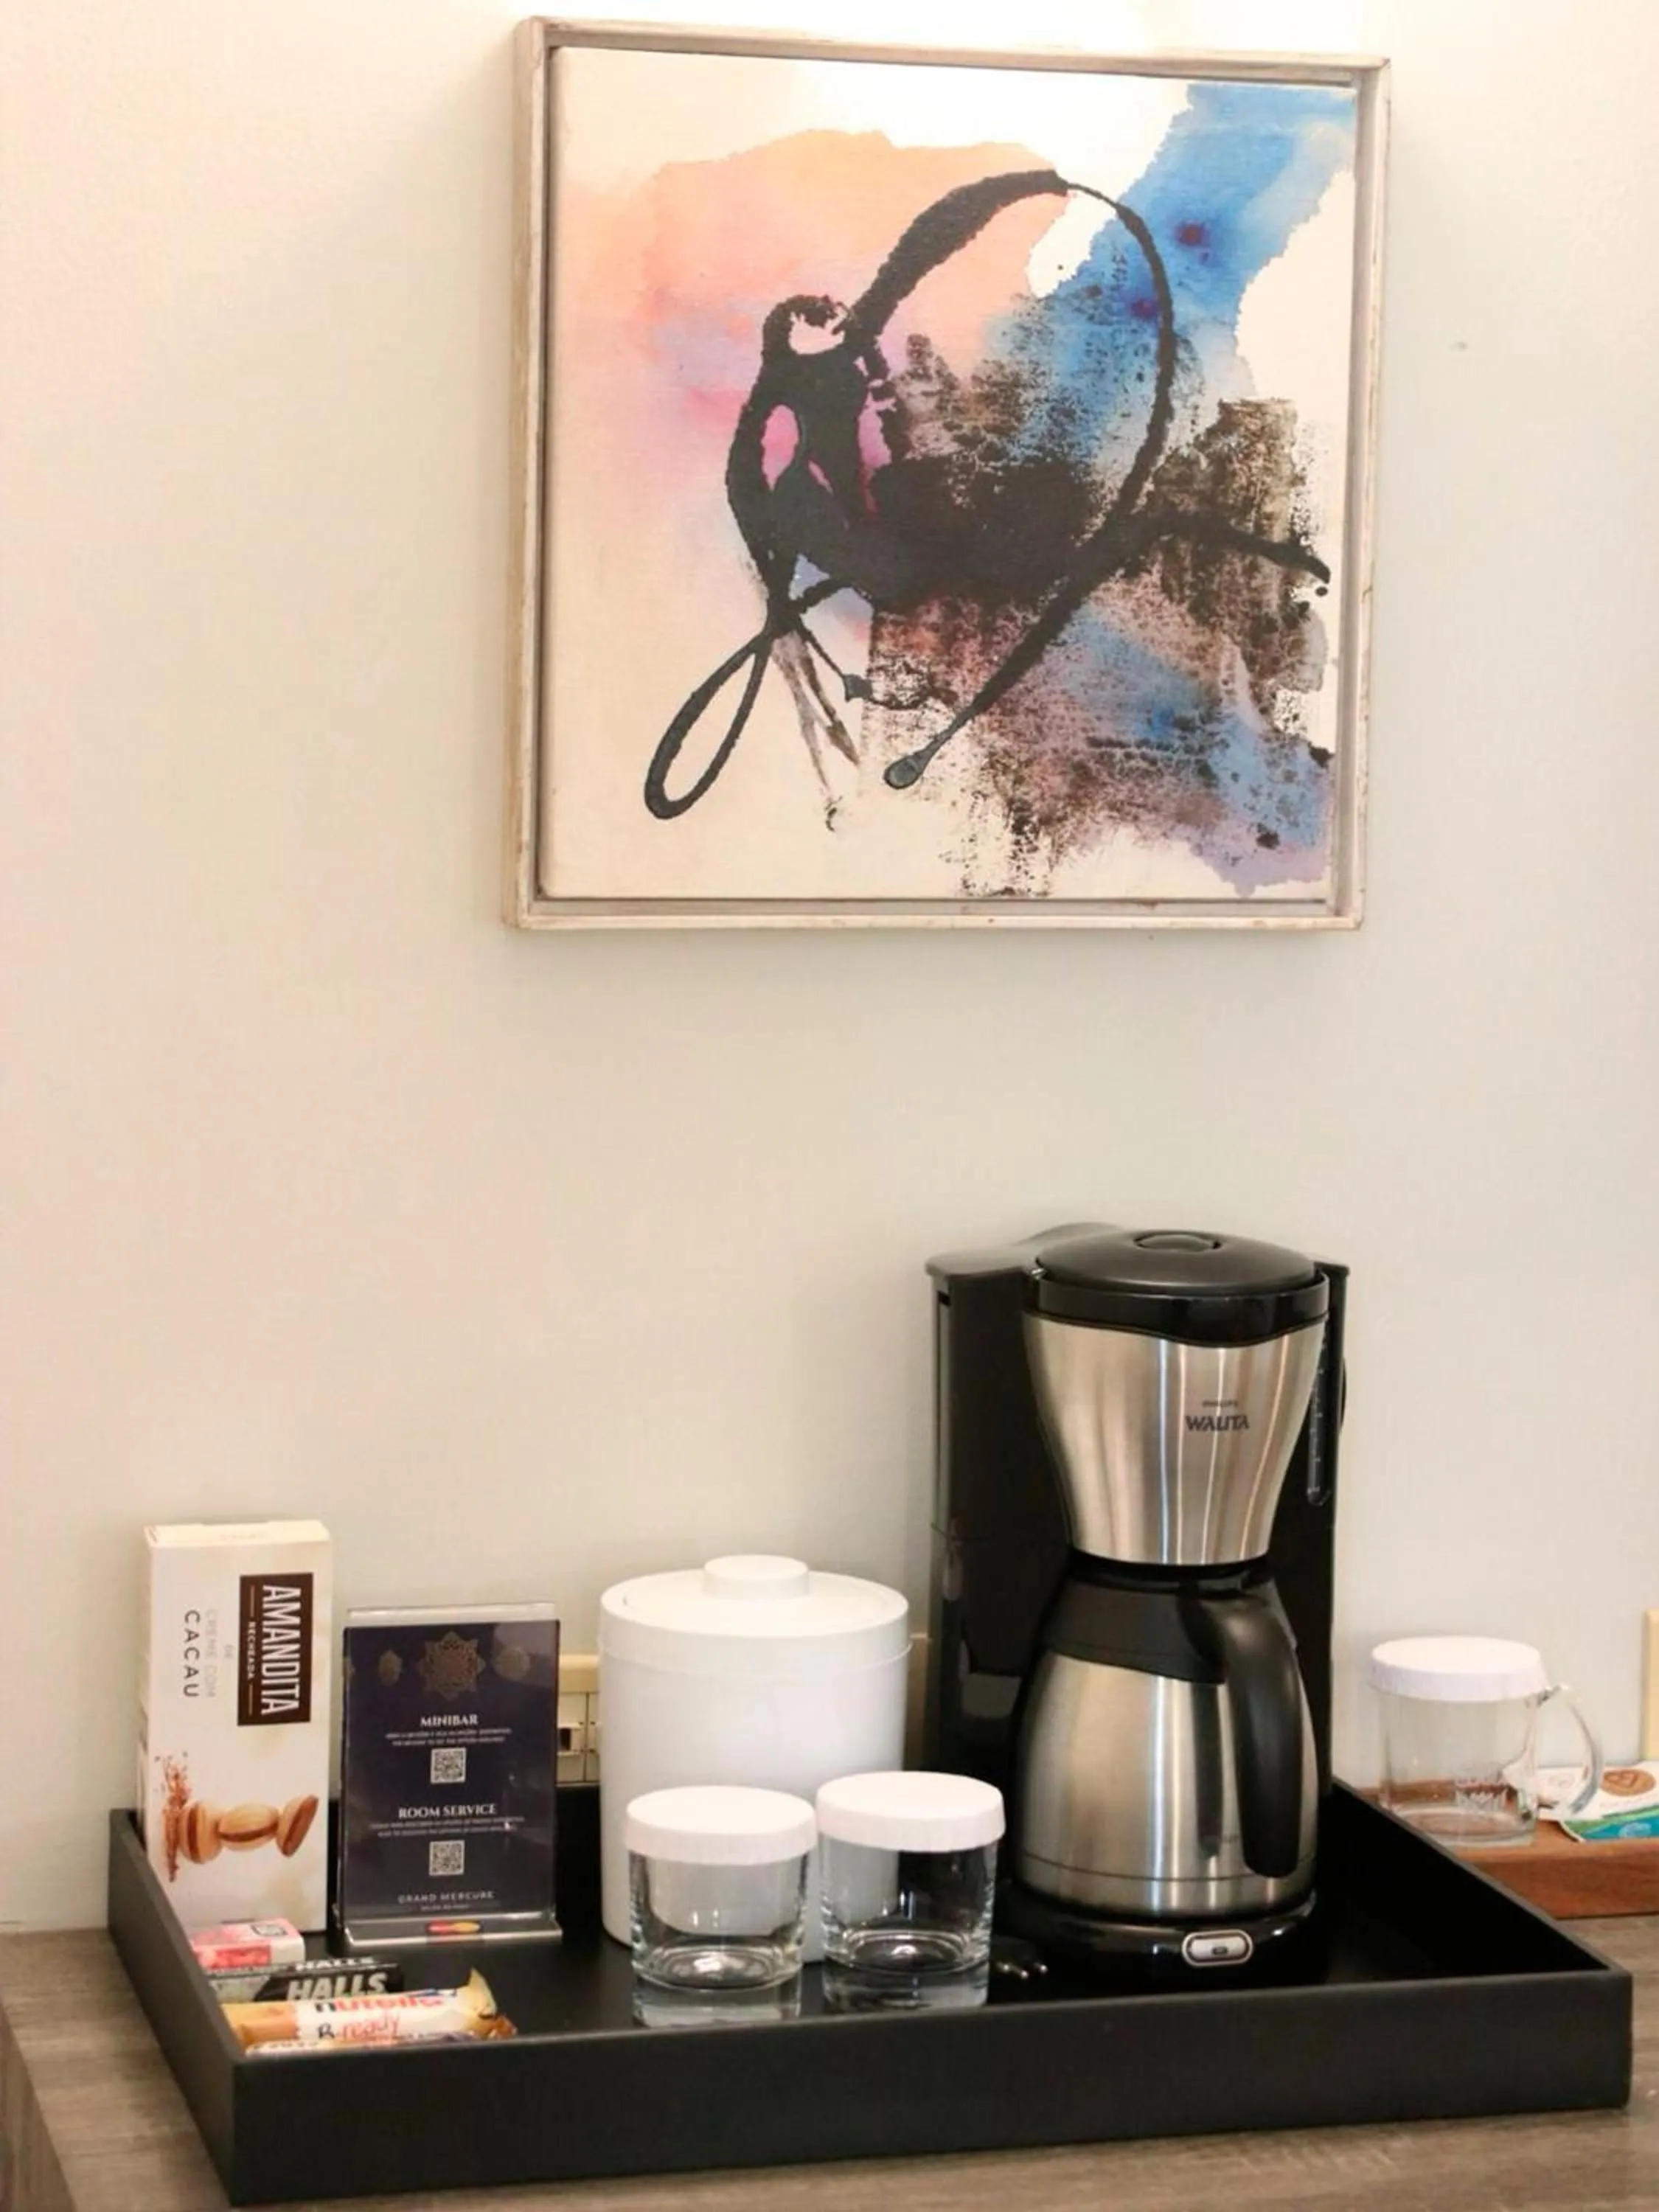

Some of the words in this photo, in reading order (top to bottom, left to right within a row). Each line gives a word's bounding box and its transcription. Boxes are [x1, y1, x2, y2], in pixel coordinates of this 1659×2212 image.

[1186, 1415, 1250, 1431] WALITA
[184, 1610, 201, 1697] CACAU
[247, 1621, 257, 1681] RECHEADA
[261, 1585, 301, 1715] AMANDITA
[420, 1714, 479, 1728] MINIBAR
[398, 1806, 440, 1819] ROOM
[442, 1804, 497, 1818] SERVICE
[397, 1893, 437, 1904] GRAND
[440, 1891, 494, 1901] MERCURE
[296, 1958, 375, 1971] HALLS
[287, 1972, 386, 2000] HALLS
